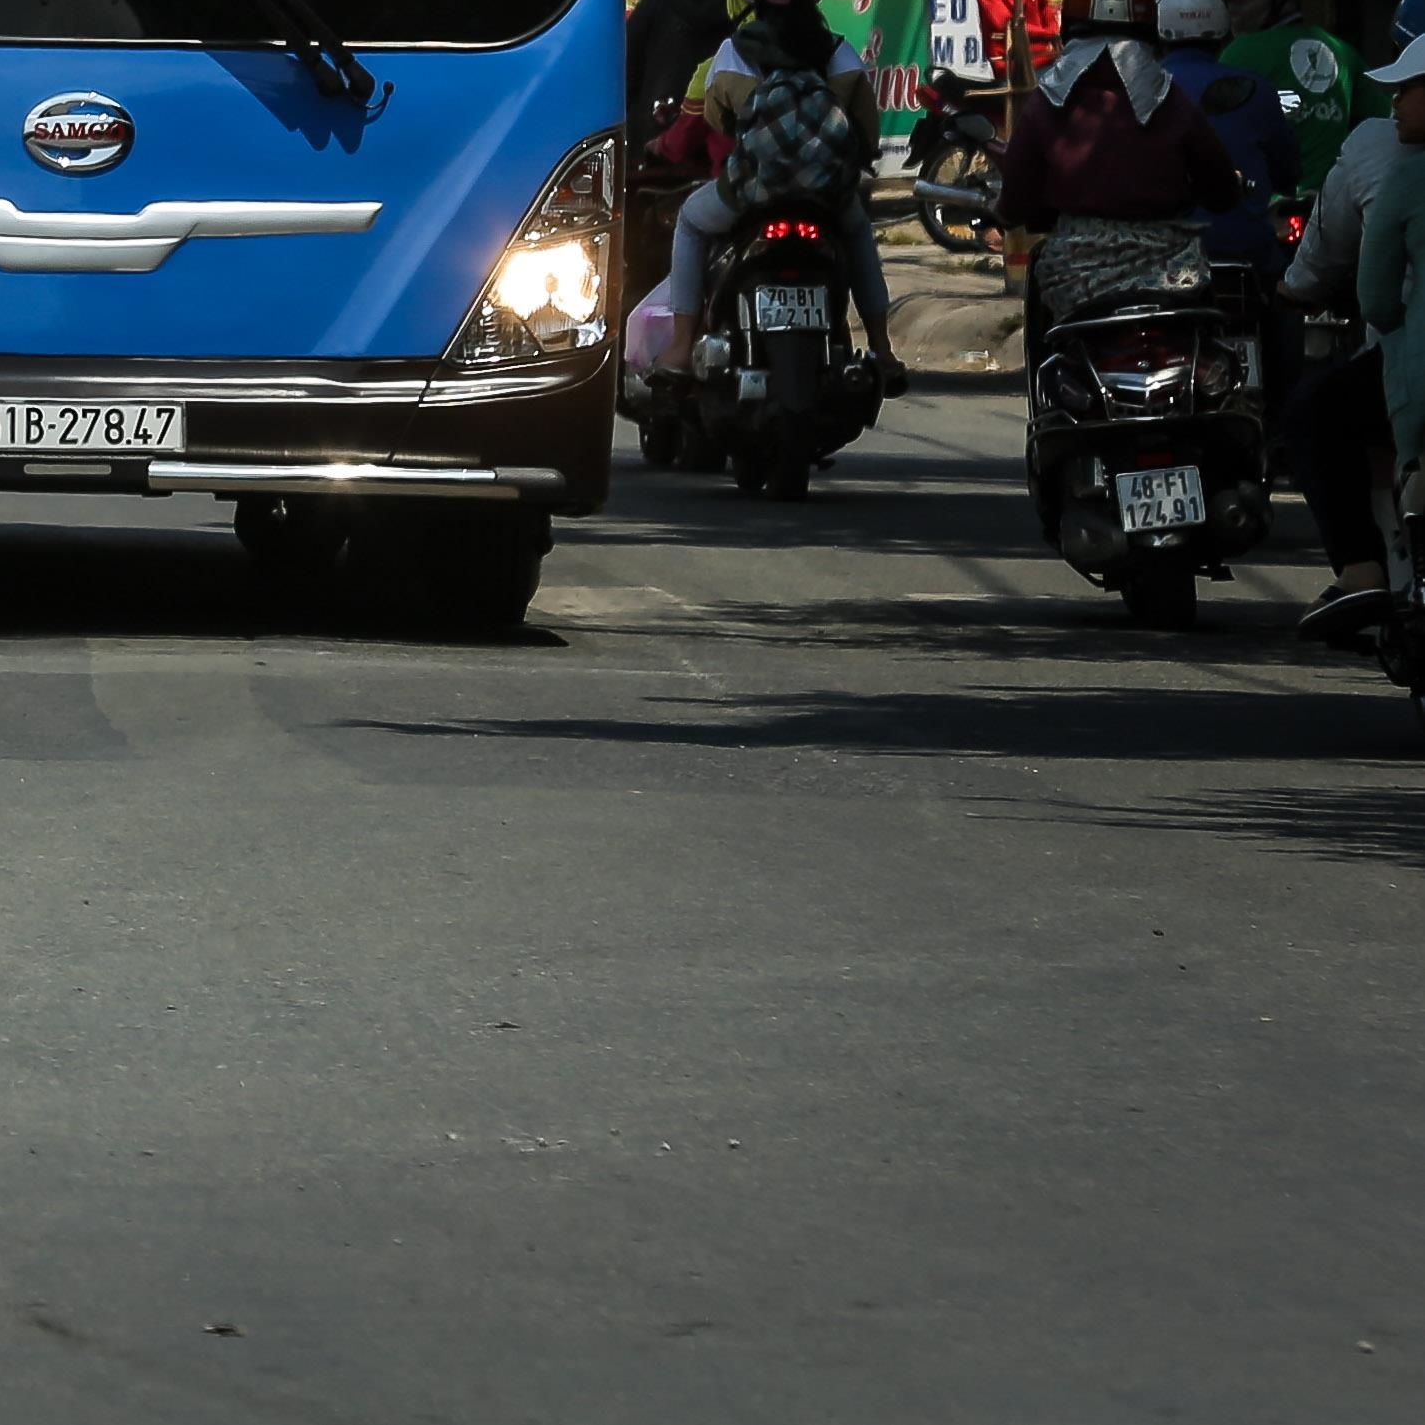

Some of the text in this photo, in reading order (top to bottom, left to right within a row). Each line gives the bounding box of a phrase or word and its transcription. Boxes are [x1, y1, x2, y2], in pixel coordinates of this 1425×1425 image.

[34, 121, 126, 141] SAMCO
[1130, 471, 1188, 500] 48-F1
[1125, 497, 1200, 528] 124.91
